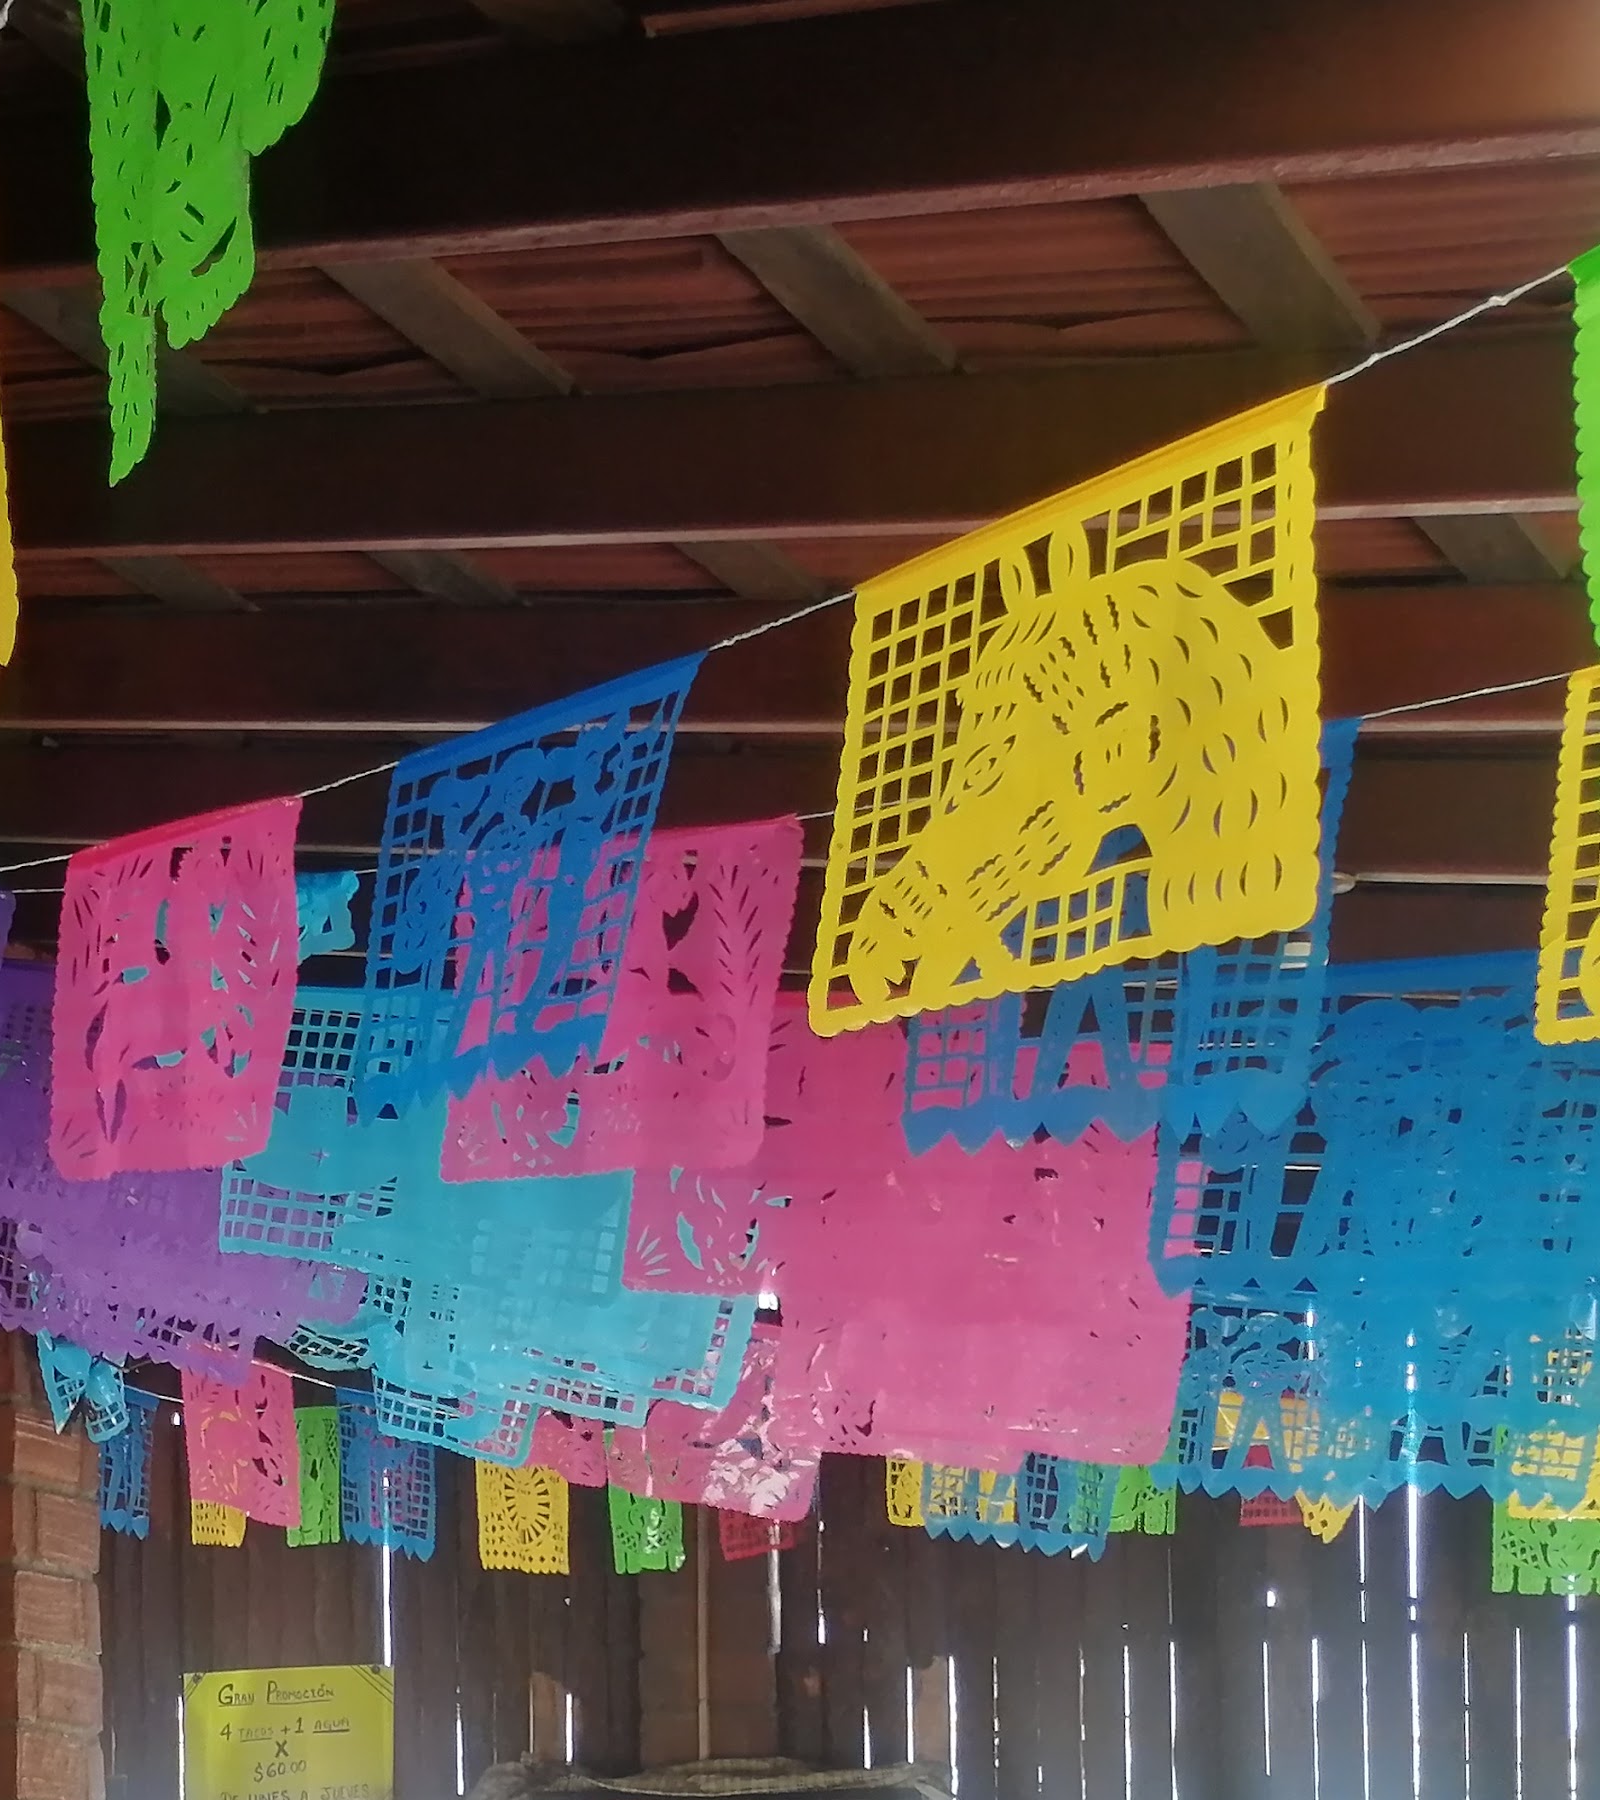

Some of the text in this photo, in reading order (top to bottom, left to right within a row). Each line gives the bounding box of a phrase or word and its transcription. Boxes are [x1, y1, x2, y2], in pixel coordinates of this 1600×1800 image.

[220, 1722, 232, 1741] 4
[238, 1727, 274, 1740] TACOS
[313, 1718, 350, 1732] AGUA
